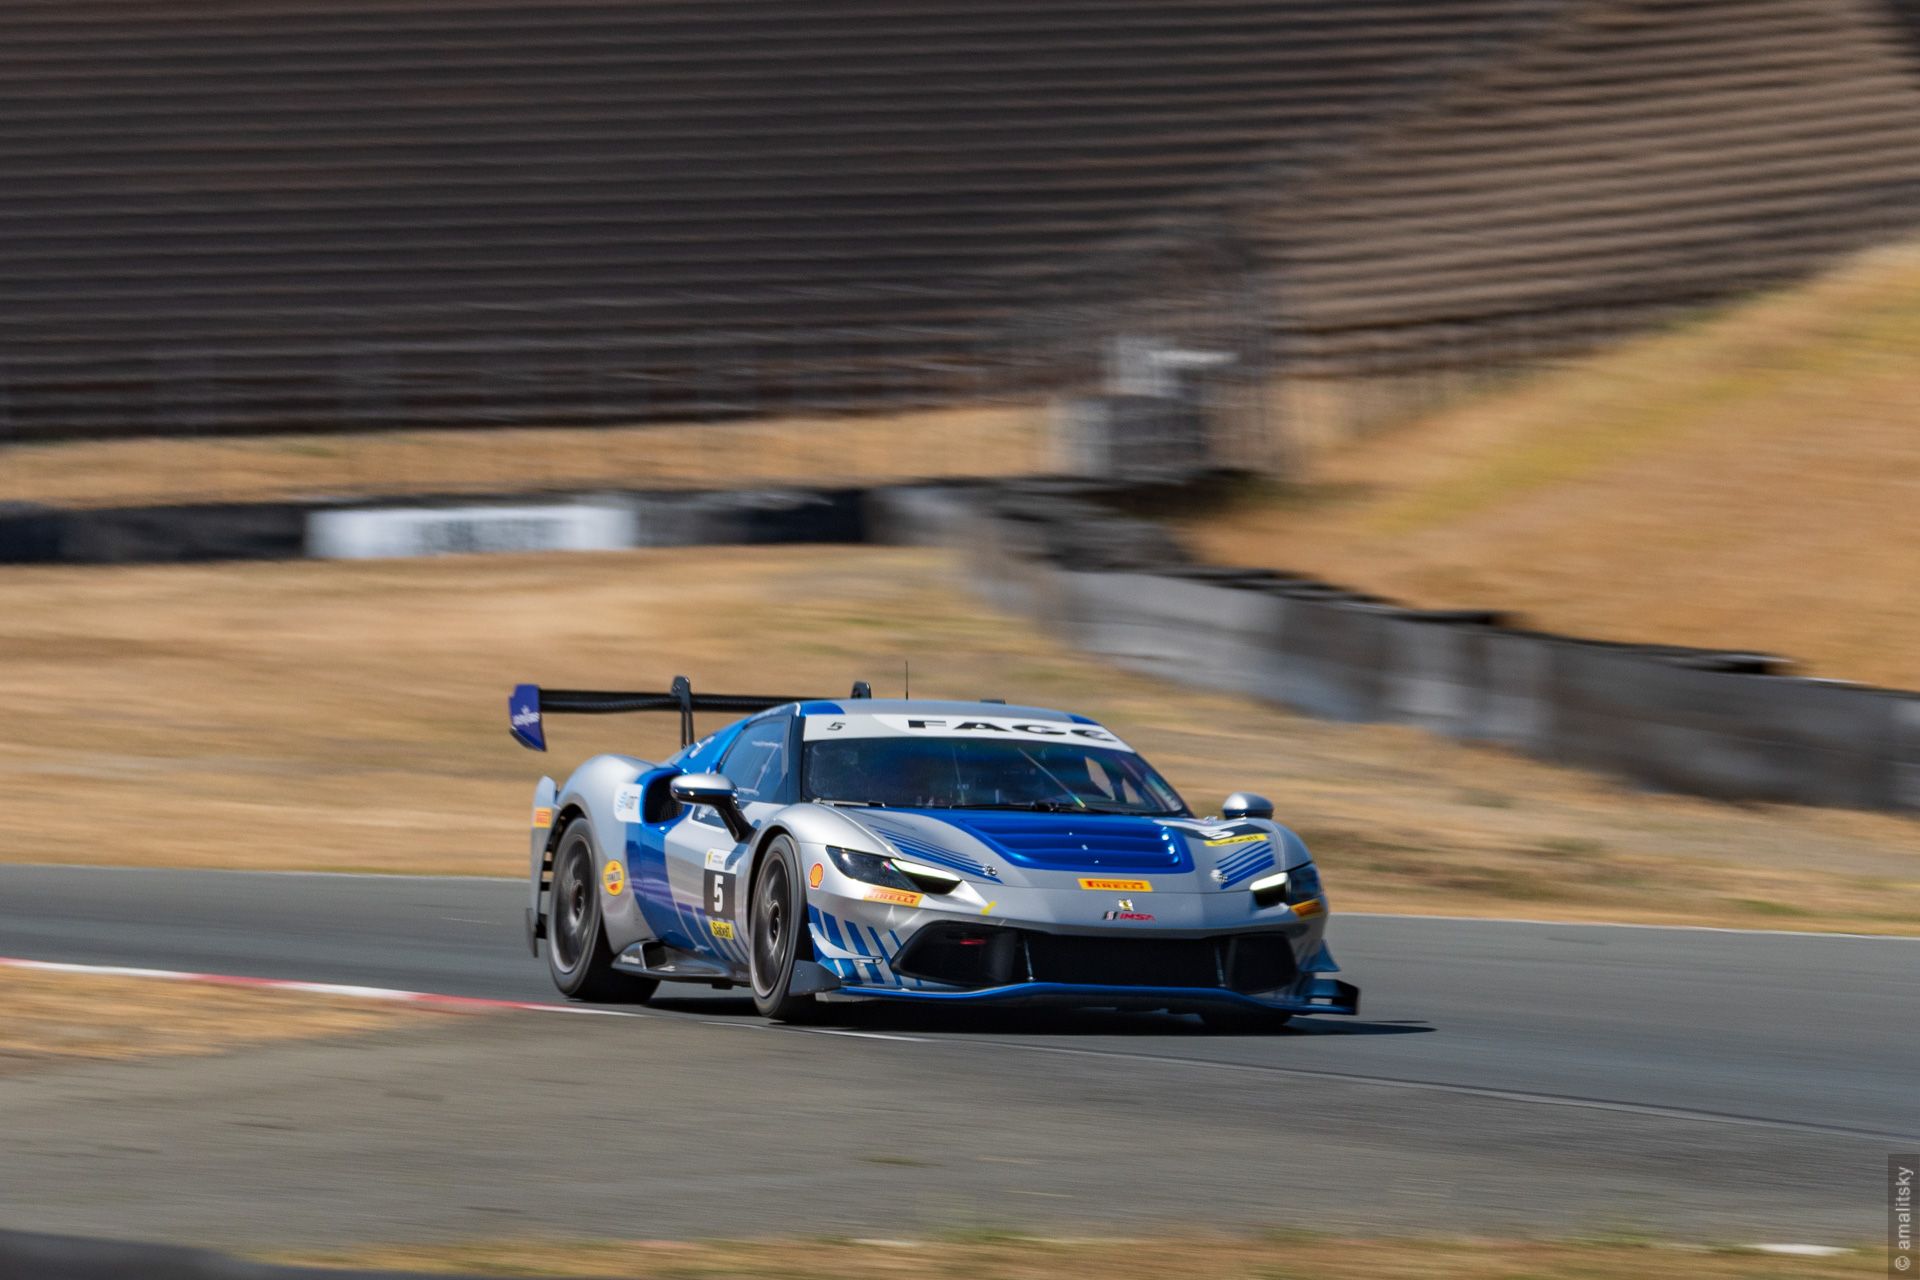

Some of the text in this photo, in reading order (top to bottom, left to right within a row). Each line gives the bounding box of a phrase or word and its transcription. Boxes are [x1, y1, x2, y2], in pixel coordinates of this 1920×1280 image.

[827, 721, 847, 731] 5
[1086, 880, 1145, 890] PIRELLI
[713, 874, 724, 913] 5
